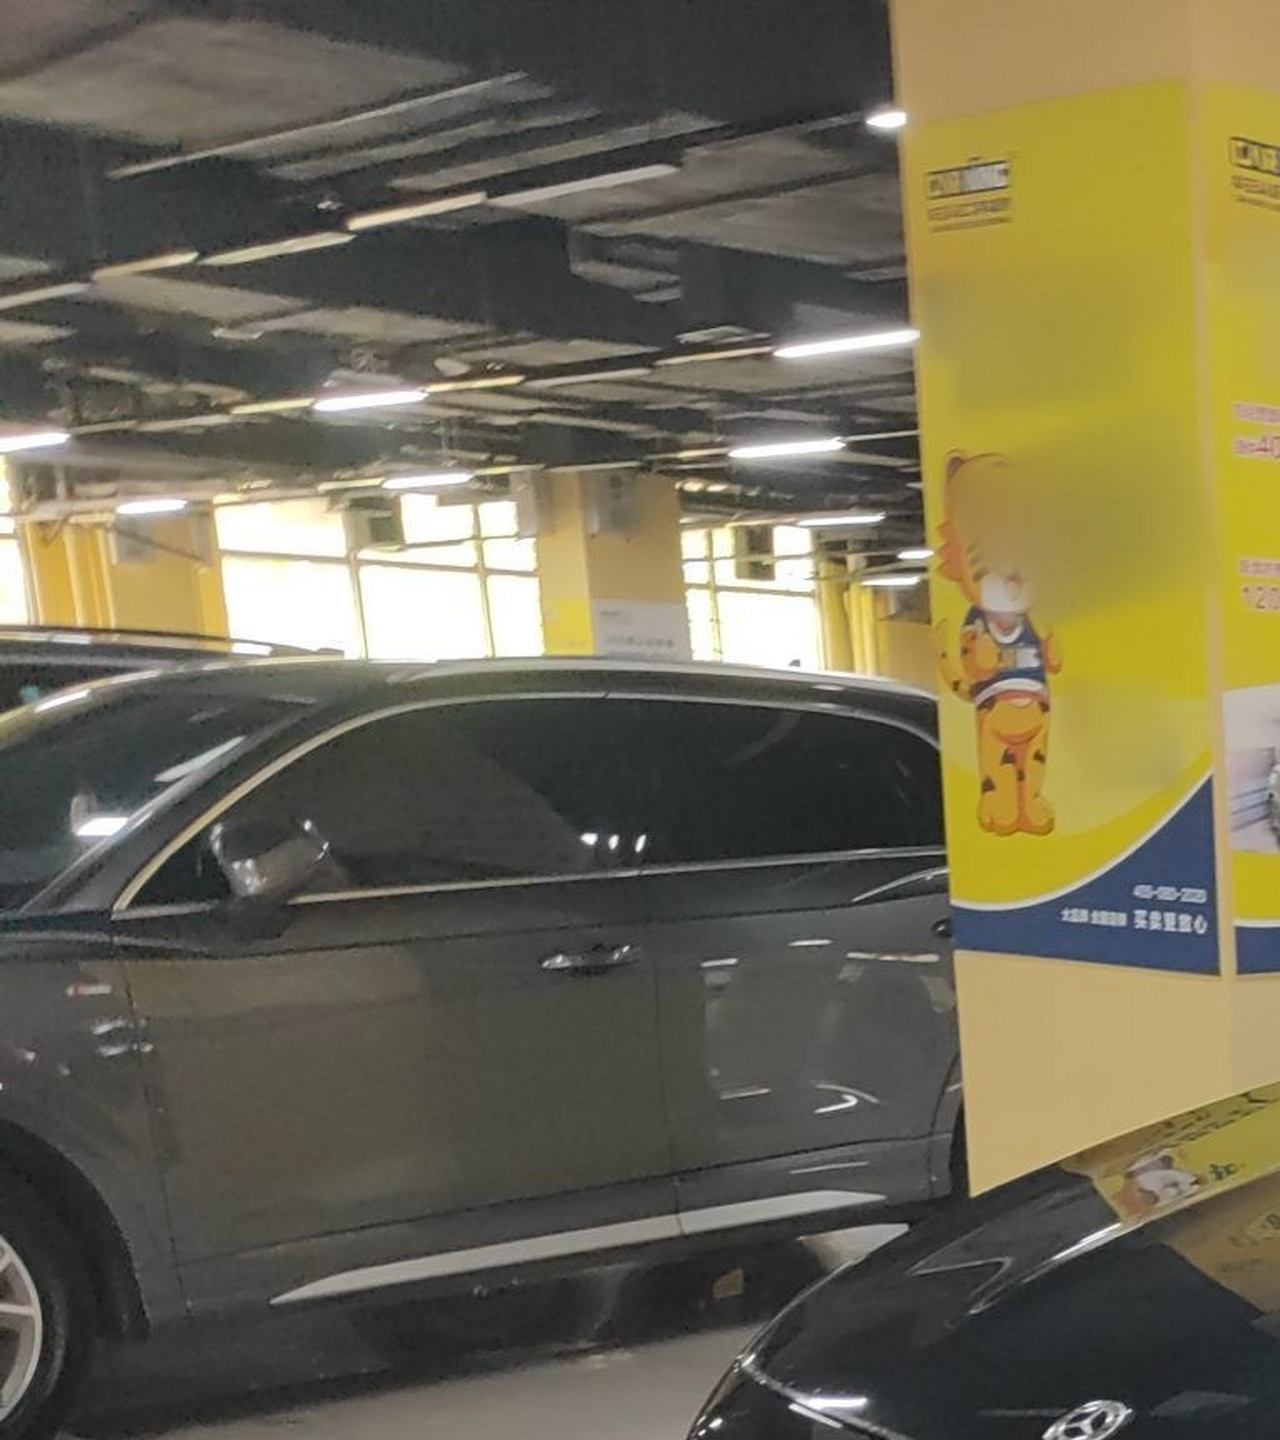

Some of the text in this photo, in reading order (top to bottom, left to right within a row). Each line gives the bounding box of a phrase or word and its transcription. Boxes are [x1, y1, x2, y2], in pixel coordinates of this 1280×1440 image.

[1133, 908, 1208, 935] 买卖更放心
